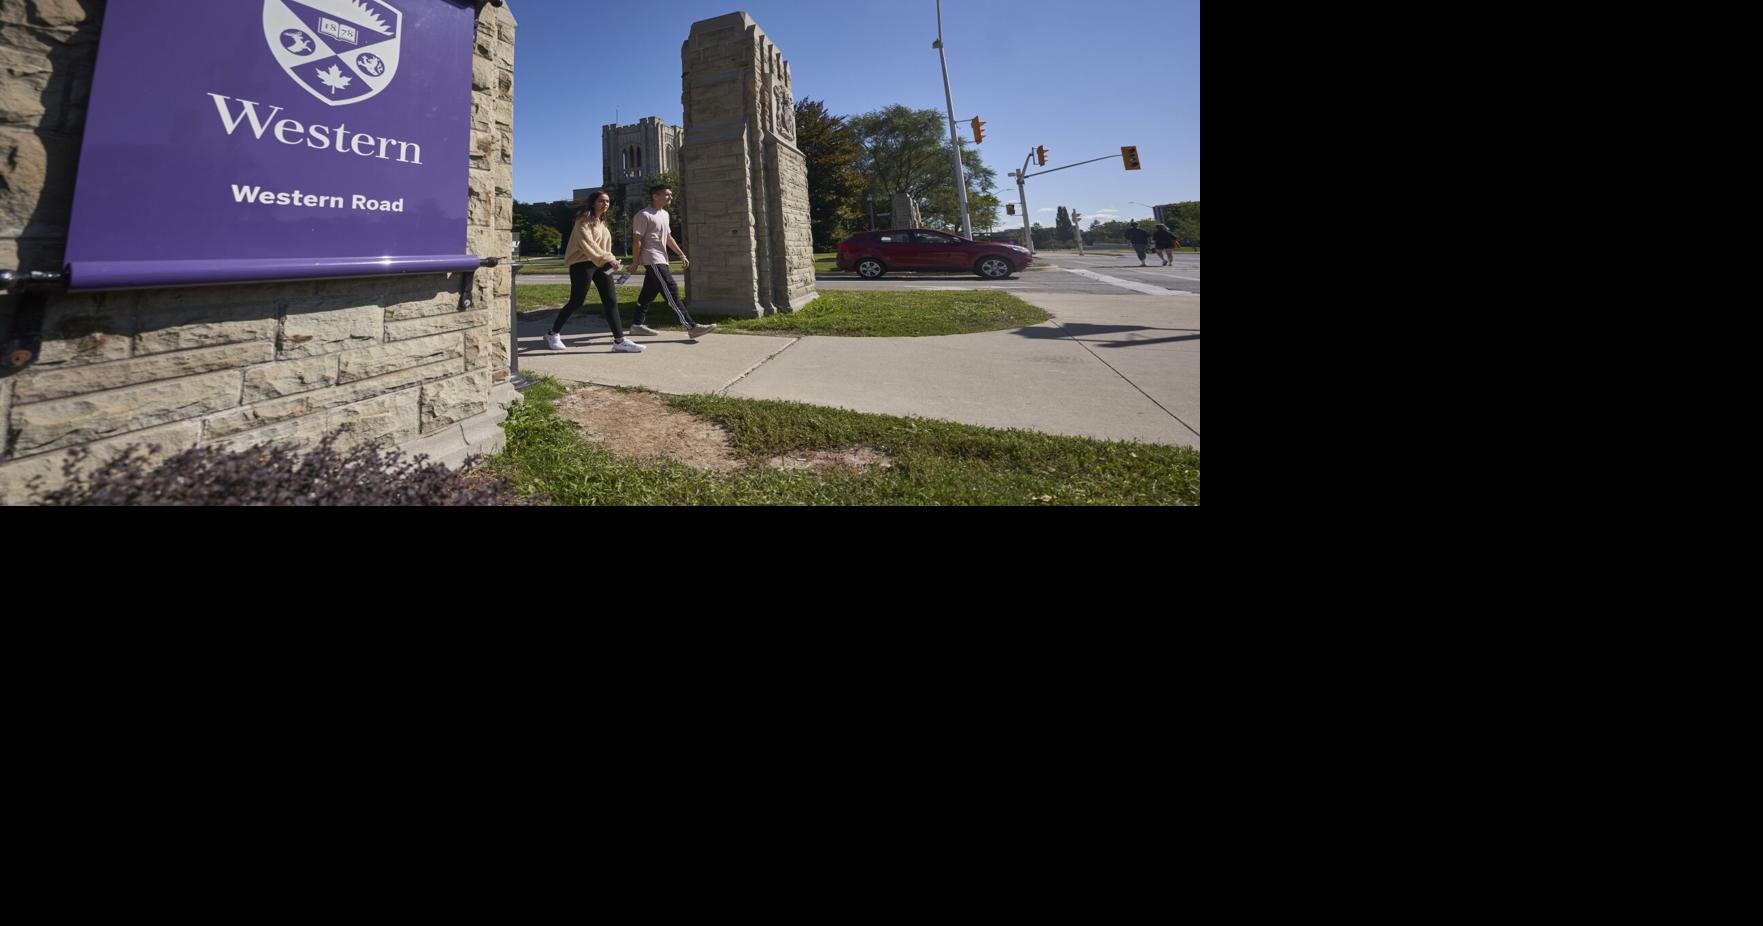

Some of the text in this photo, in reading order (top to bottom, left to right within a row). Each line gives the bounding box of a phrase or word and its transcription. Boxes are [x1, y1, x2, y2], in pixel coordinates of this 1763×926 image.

[207, 92, 423, 165] Western
[231, 184, 404, 213] Western Road
